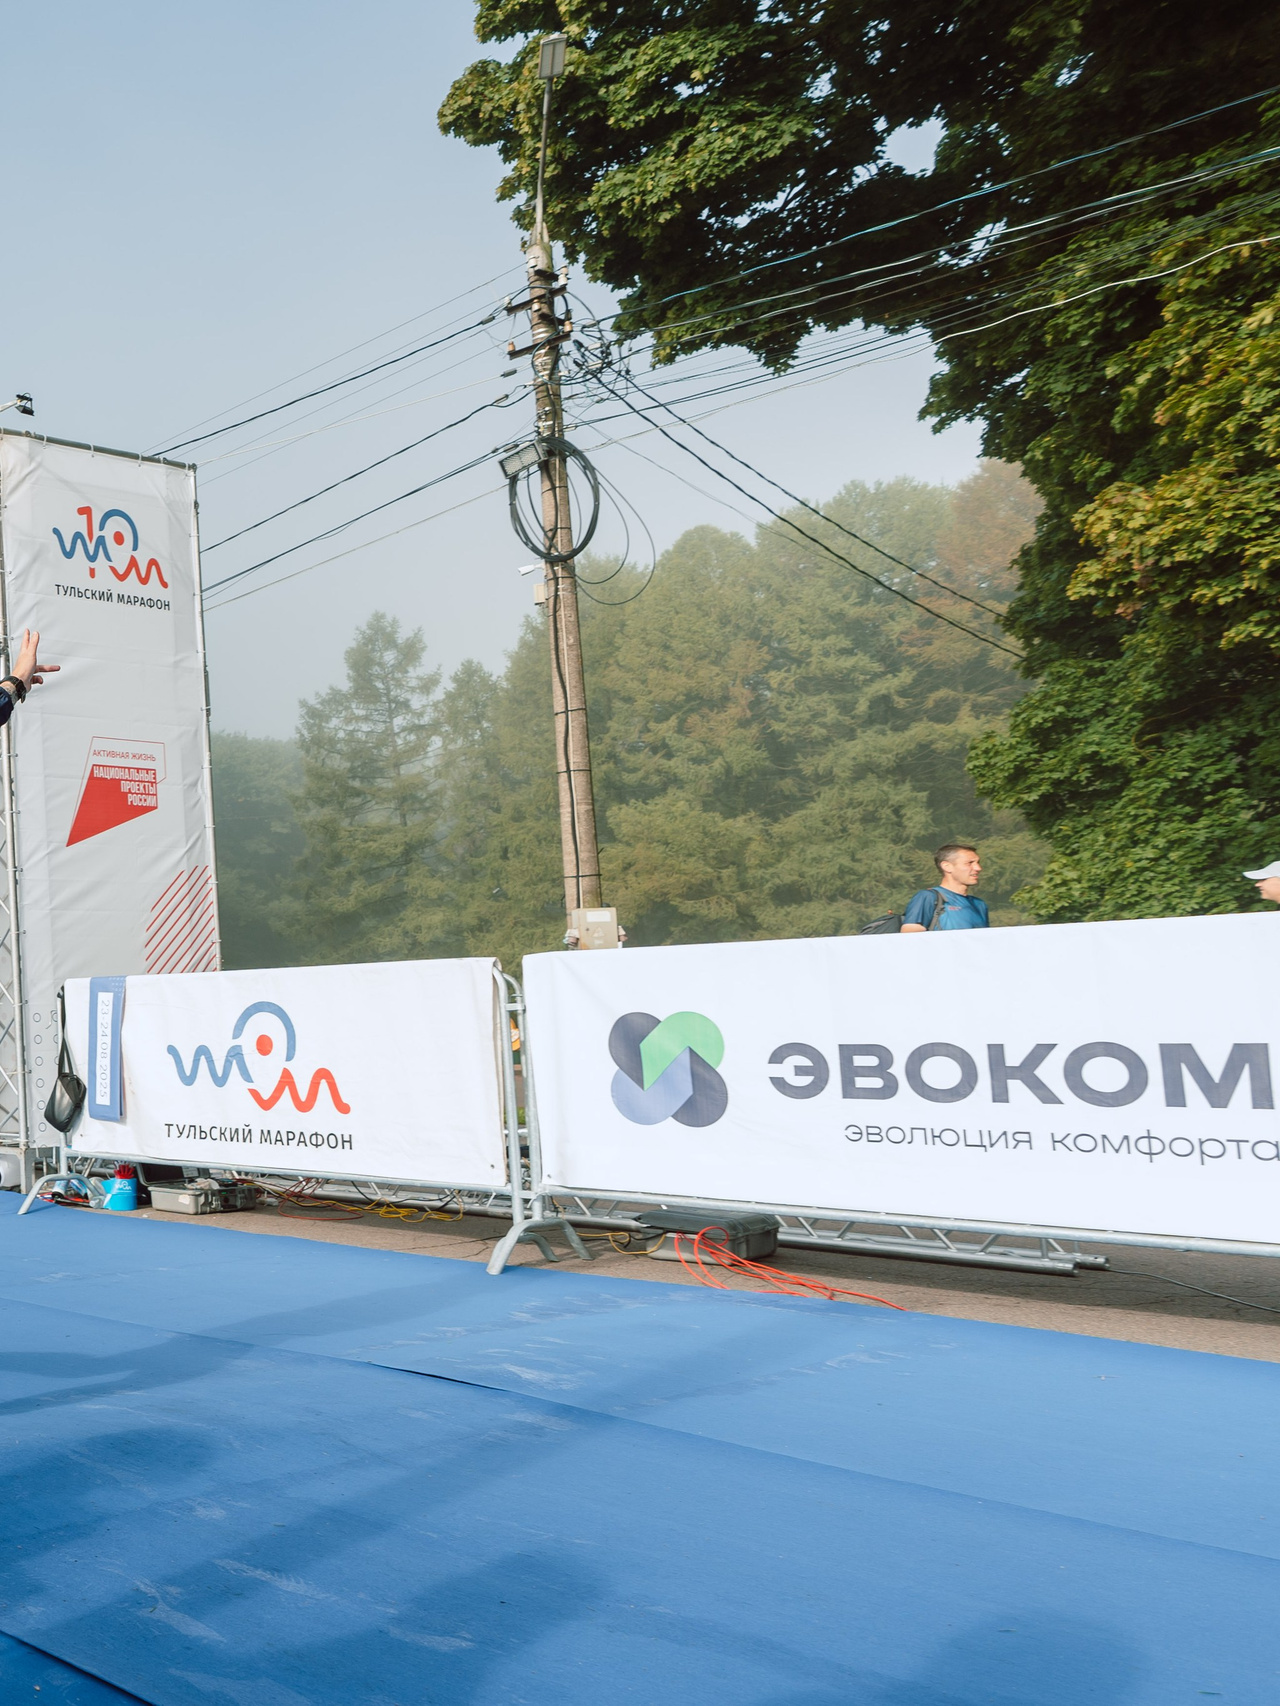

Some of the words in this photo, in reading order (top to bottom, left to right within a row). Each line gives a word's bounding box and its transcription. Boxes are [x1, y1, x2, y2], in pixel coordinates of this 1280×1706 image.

[54, 584, 113, 603] ТУЛЬСКИЙ
[117, 593, 170, 611] МАРАФОН
[92, 749, 129, 759] АКТИВНАЯ
[131, 752, 156, 762] ЖИЗНЬ
[93, 765, 156, 782] НАЦИОНАЛЬНЫЕ
[121, 780, 156, 794] ПРОЕКТЫ
[127, 793, 157, 807] РОССИИ
[100, 999, 110, 1098] 23-24.08.2025
[767, 1041, 1276, 1110] ЭВОКОМ
[164, 1123, 253, 1144] ТУЛЬСКИЙ
[260, 1129, 353, 1150] МАРАФОН
[844, 1124, 1033, 1152] эволюция
[1050, 1129, 1280, 1165] комфорта
